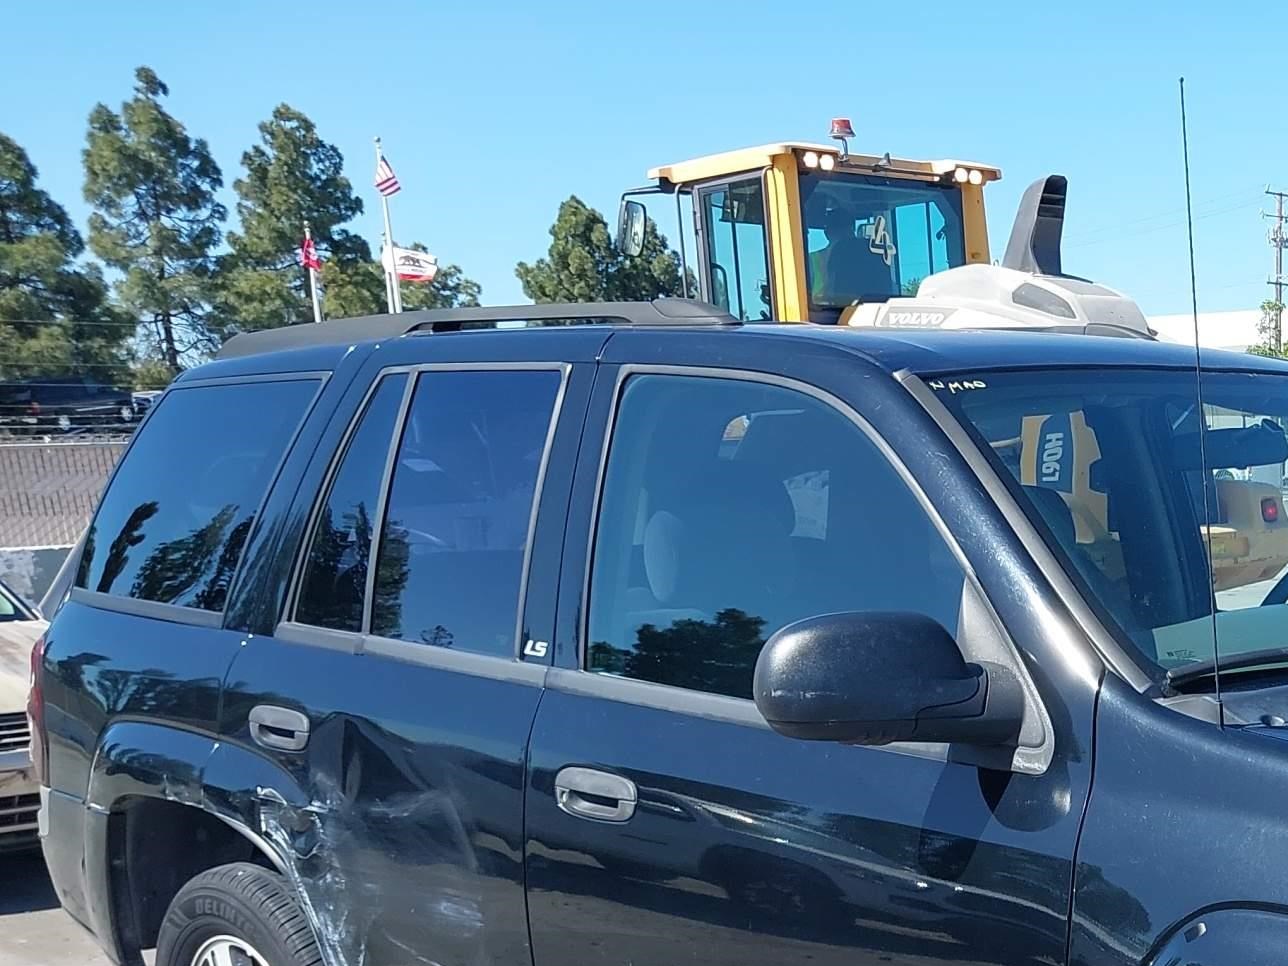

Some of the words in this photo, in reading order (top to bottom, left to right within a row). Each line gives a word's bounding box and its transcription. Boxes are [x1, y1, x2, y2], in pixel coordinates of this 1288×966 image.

[888, 312, 945, 325] VOLVO
[1041, 432, 1064, 482] L90H
[523, 639, 549, 657] LS
